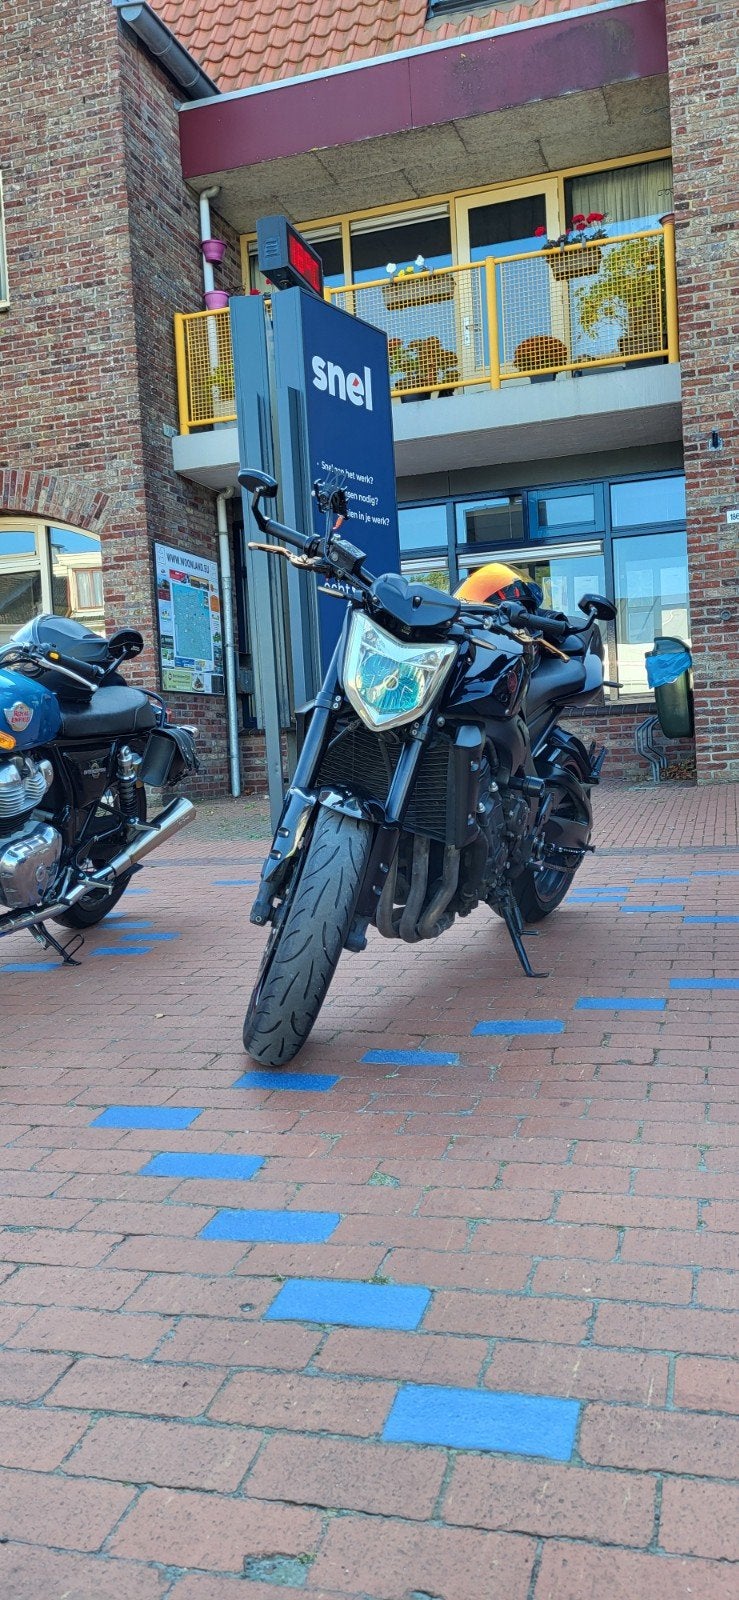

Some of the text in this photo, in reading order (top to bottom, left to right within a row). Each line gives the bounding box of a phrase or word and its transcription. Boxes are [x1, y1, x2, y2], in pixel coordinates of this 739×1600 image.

[312, 355, 373, 411] snel
[345, 469, 356, 480] het
[356, 474, 374, 485] werk?
[358, 494, 379, 507] nodig?
[358, 511, 365, 521] in
[365, 513, 371, 523] je
[372, 516, 390, 526] werk?
